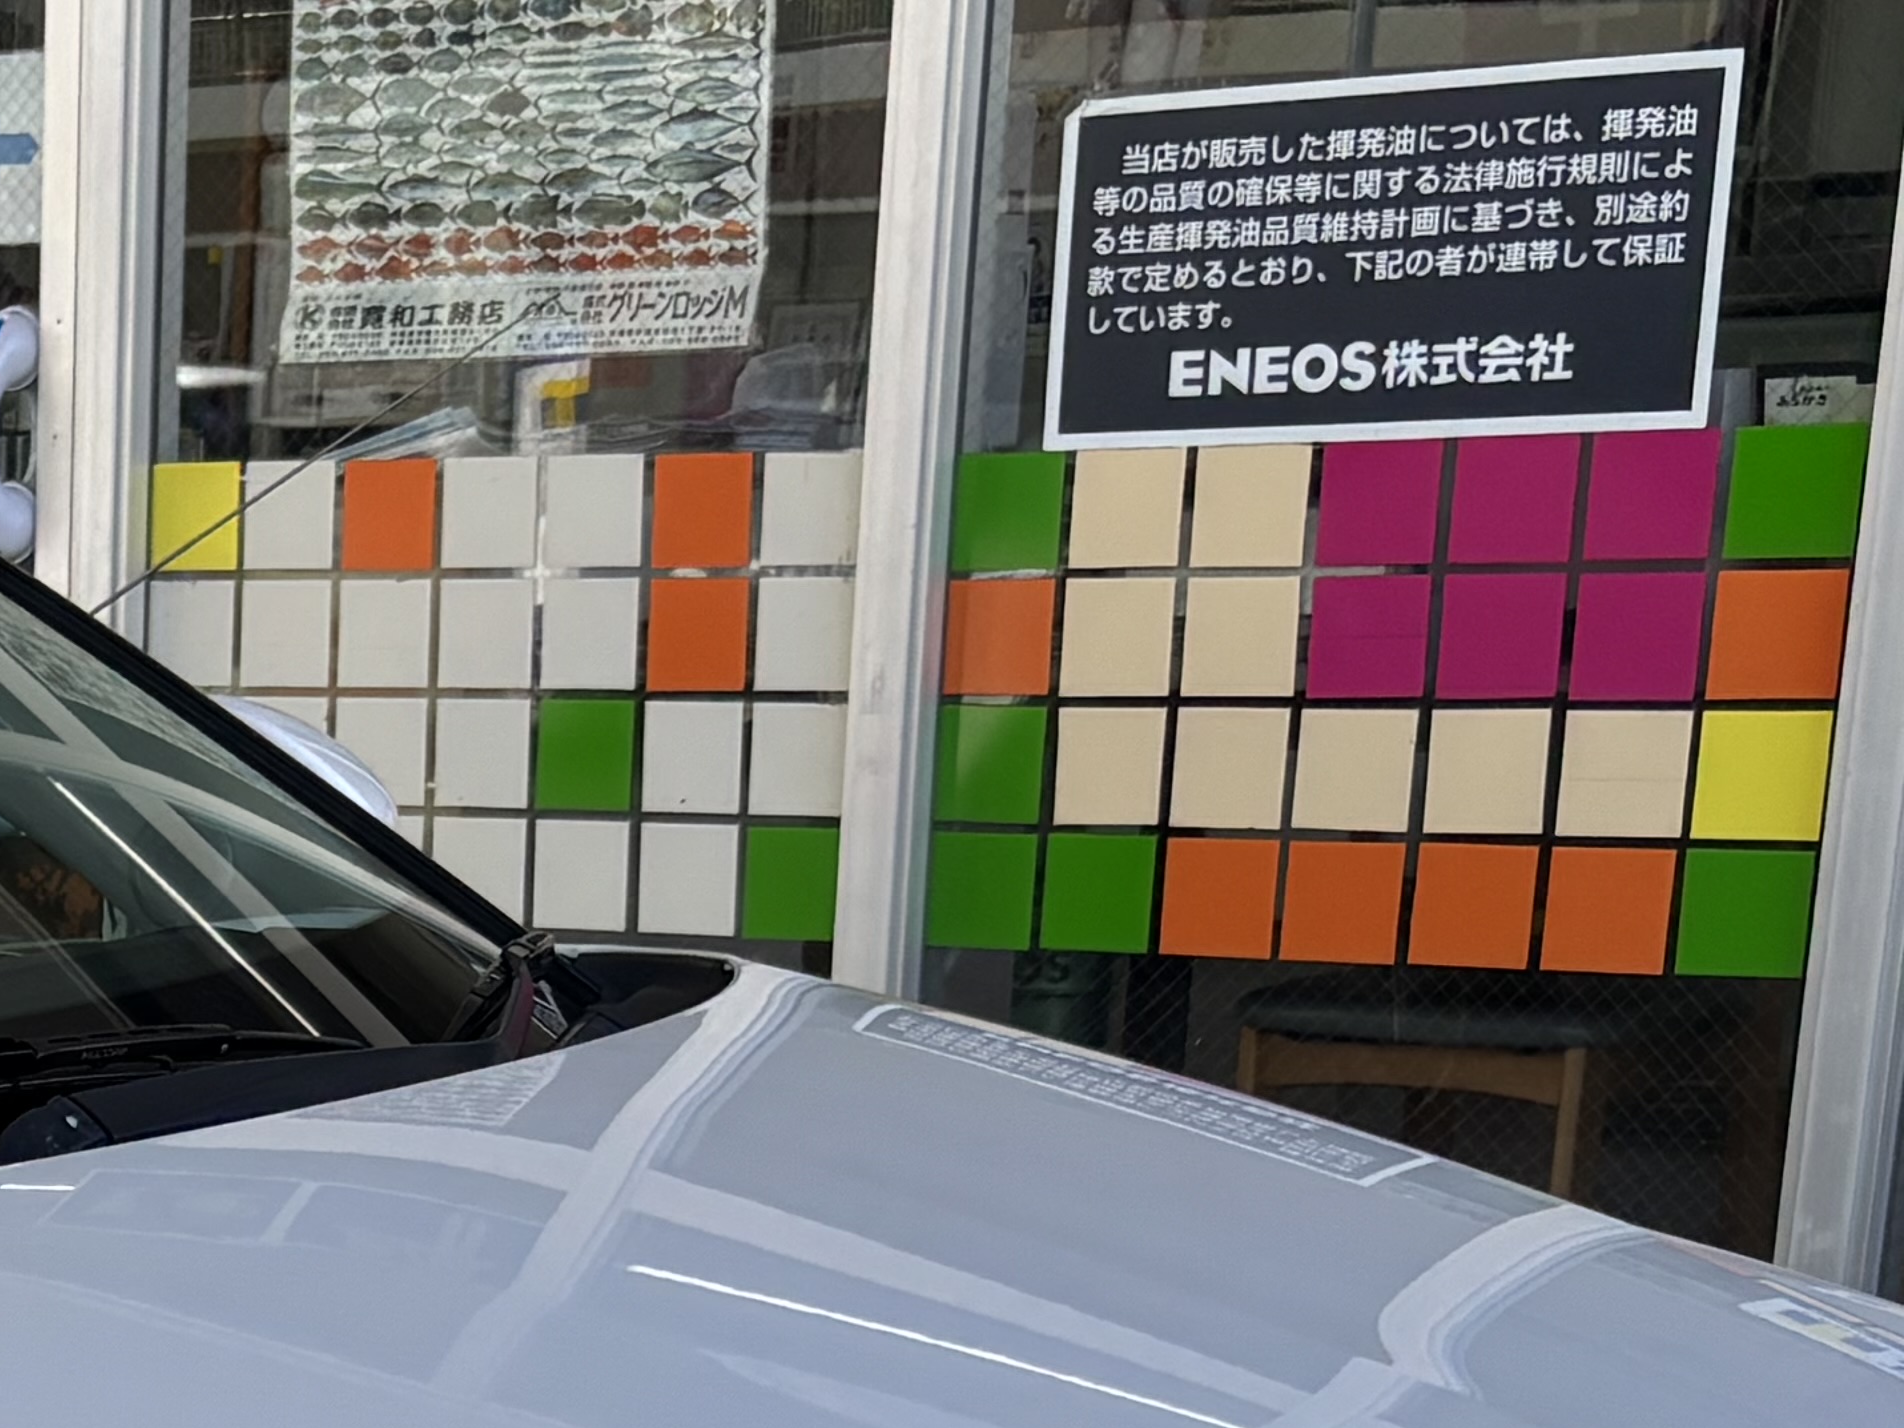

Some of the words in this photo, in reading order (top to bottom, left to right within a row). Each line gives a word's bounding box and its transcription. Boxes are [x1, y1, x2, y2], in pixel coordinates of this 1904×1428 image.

[1121, 103, 1698, 175] 当店が販売した揮発油については、揮発油
[1092, 148, 1694, 217] 等の品質の確保等に関する法律施行規則によ
[1091, 189, 1690, 256] る生産揮発油品質維持計画に基づき、別途約
[1086, 232, 1688, 298] 款で定めるとおり、下記の者が連帯して保証
[1088, 300, 1233, 335] しています。
